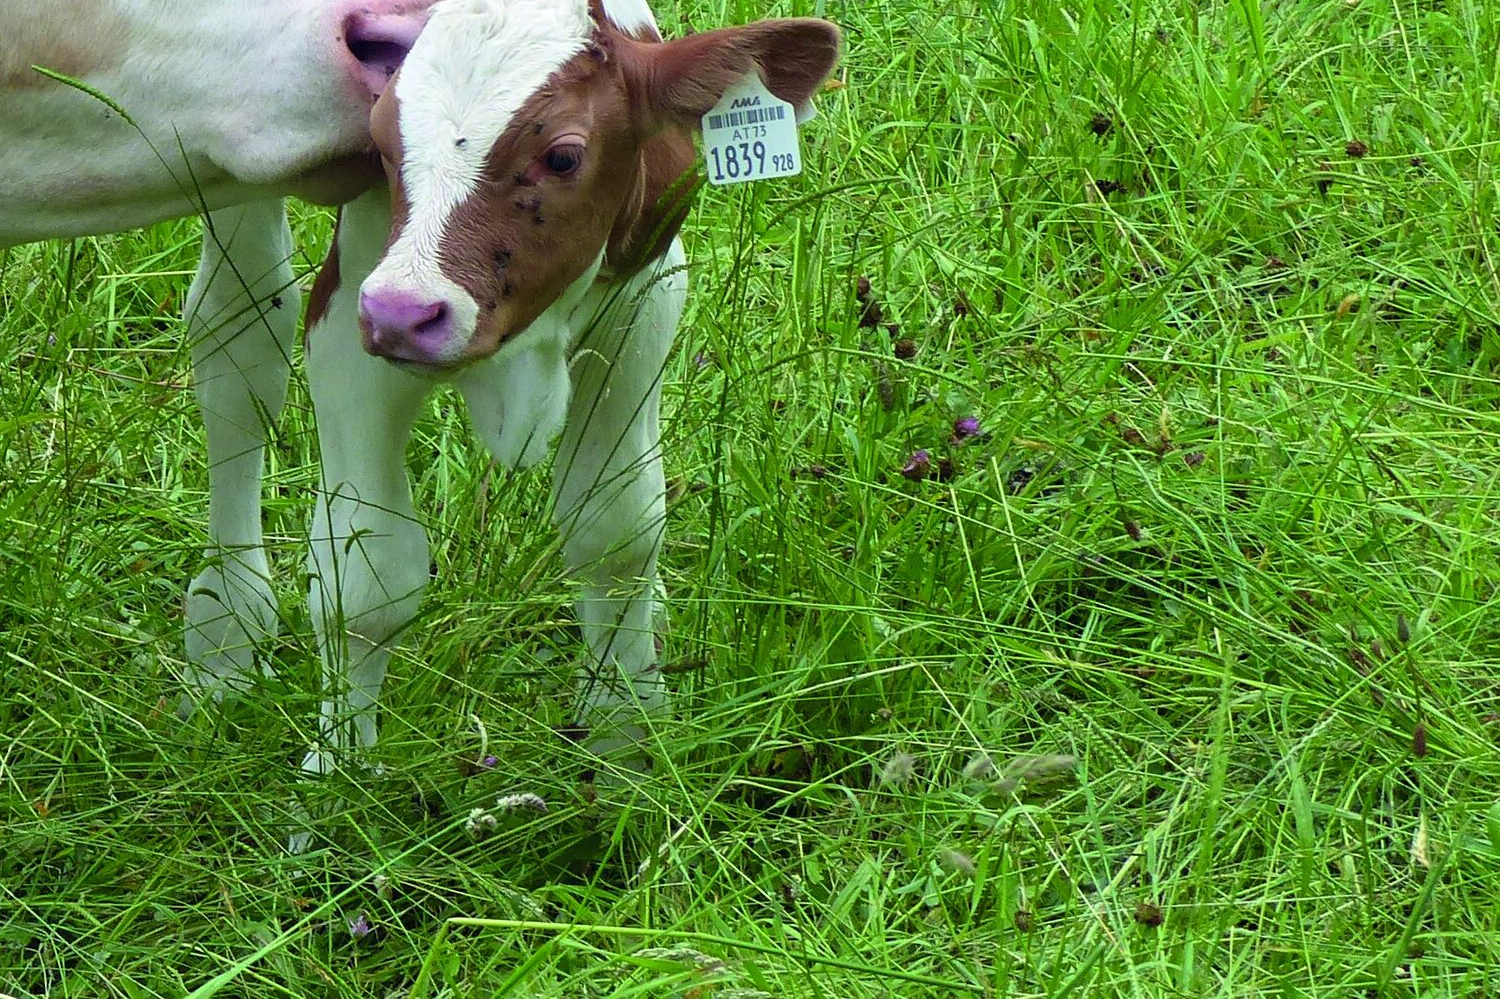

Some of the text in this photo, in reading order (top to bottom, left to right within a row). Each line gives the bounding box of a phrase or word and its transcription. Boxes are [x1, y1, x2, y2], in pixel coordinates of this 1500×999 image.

[730, 96, 761, 109] AMA
[710, 141, 794, 181] 1839 928
